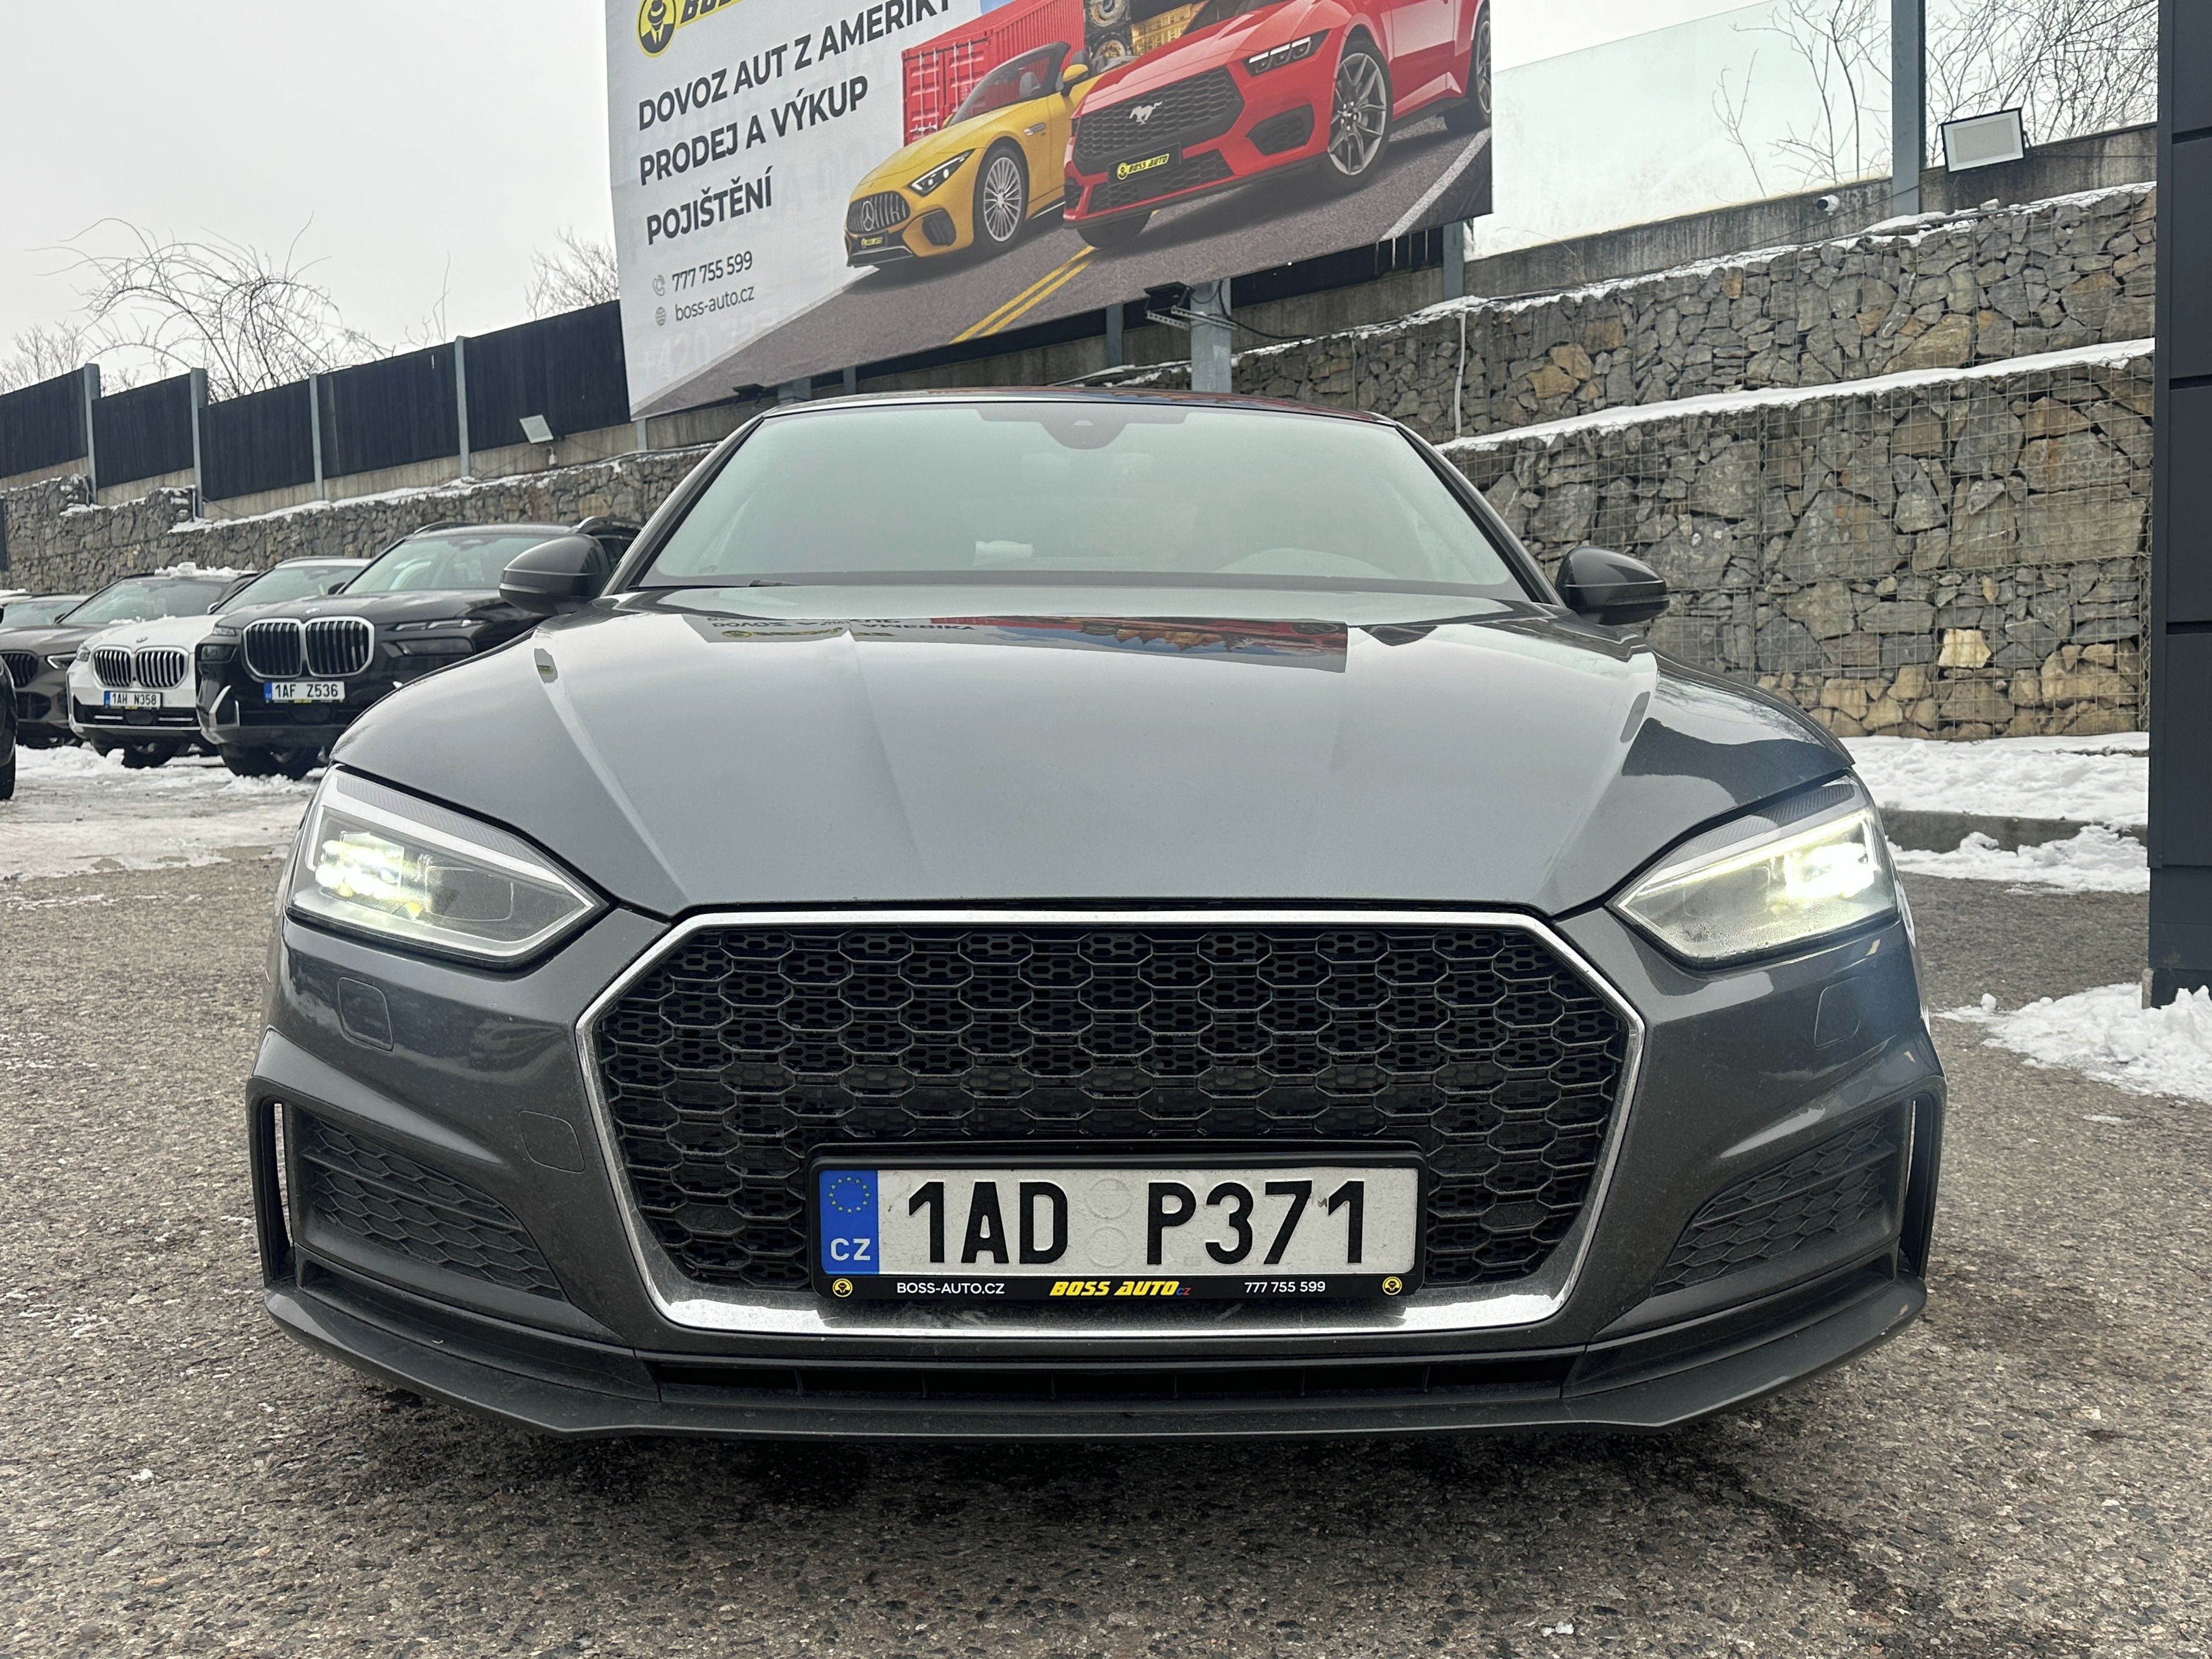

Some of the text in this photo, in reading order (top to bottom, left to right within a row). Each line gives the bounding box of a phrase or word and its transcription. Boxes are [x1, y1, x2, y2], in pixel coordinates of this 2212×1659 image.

[639, 68, 728, 131] DOVOZ
[733, 43, 788, 95] AUT
[794, 34, 812, 71] Z
[640, 76, 868, 187] PRODEJ A VÝKUP
[646, 165, 774, 246] POJIŠTĚNÍ
[672, 250, 753, 292] 777 755 599
[675, 286, 755, 322] boss-auto.cz
[112, 693, 127, 704] 1AH
[134, 694, 156, 706] N358
[275, 684, 338, 698] 1AF Z536
[909, 1181, 1364, 1265] 1AD P371
[830, 1238, 871, 1261] CZ
[897, 1282, 1005, 1294] BOSS-AUTO.CZ
[1049, 1281, 1111, 1296] BOSS
[1113, 1281, 1180, 1296] AUTO
[1244, 1282, 1268, 1293] 777
[1271, 1281, 1296, 1293] 755
[1300, 1281, 1326, 1292] 599
